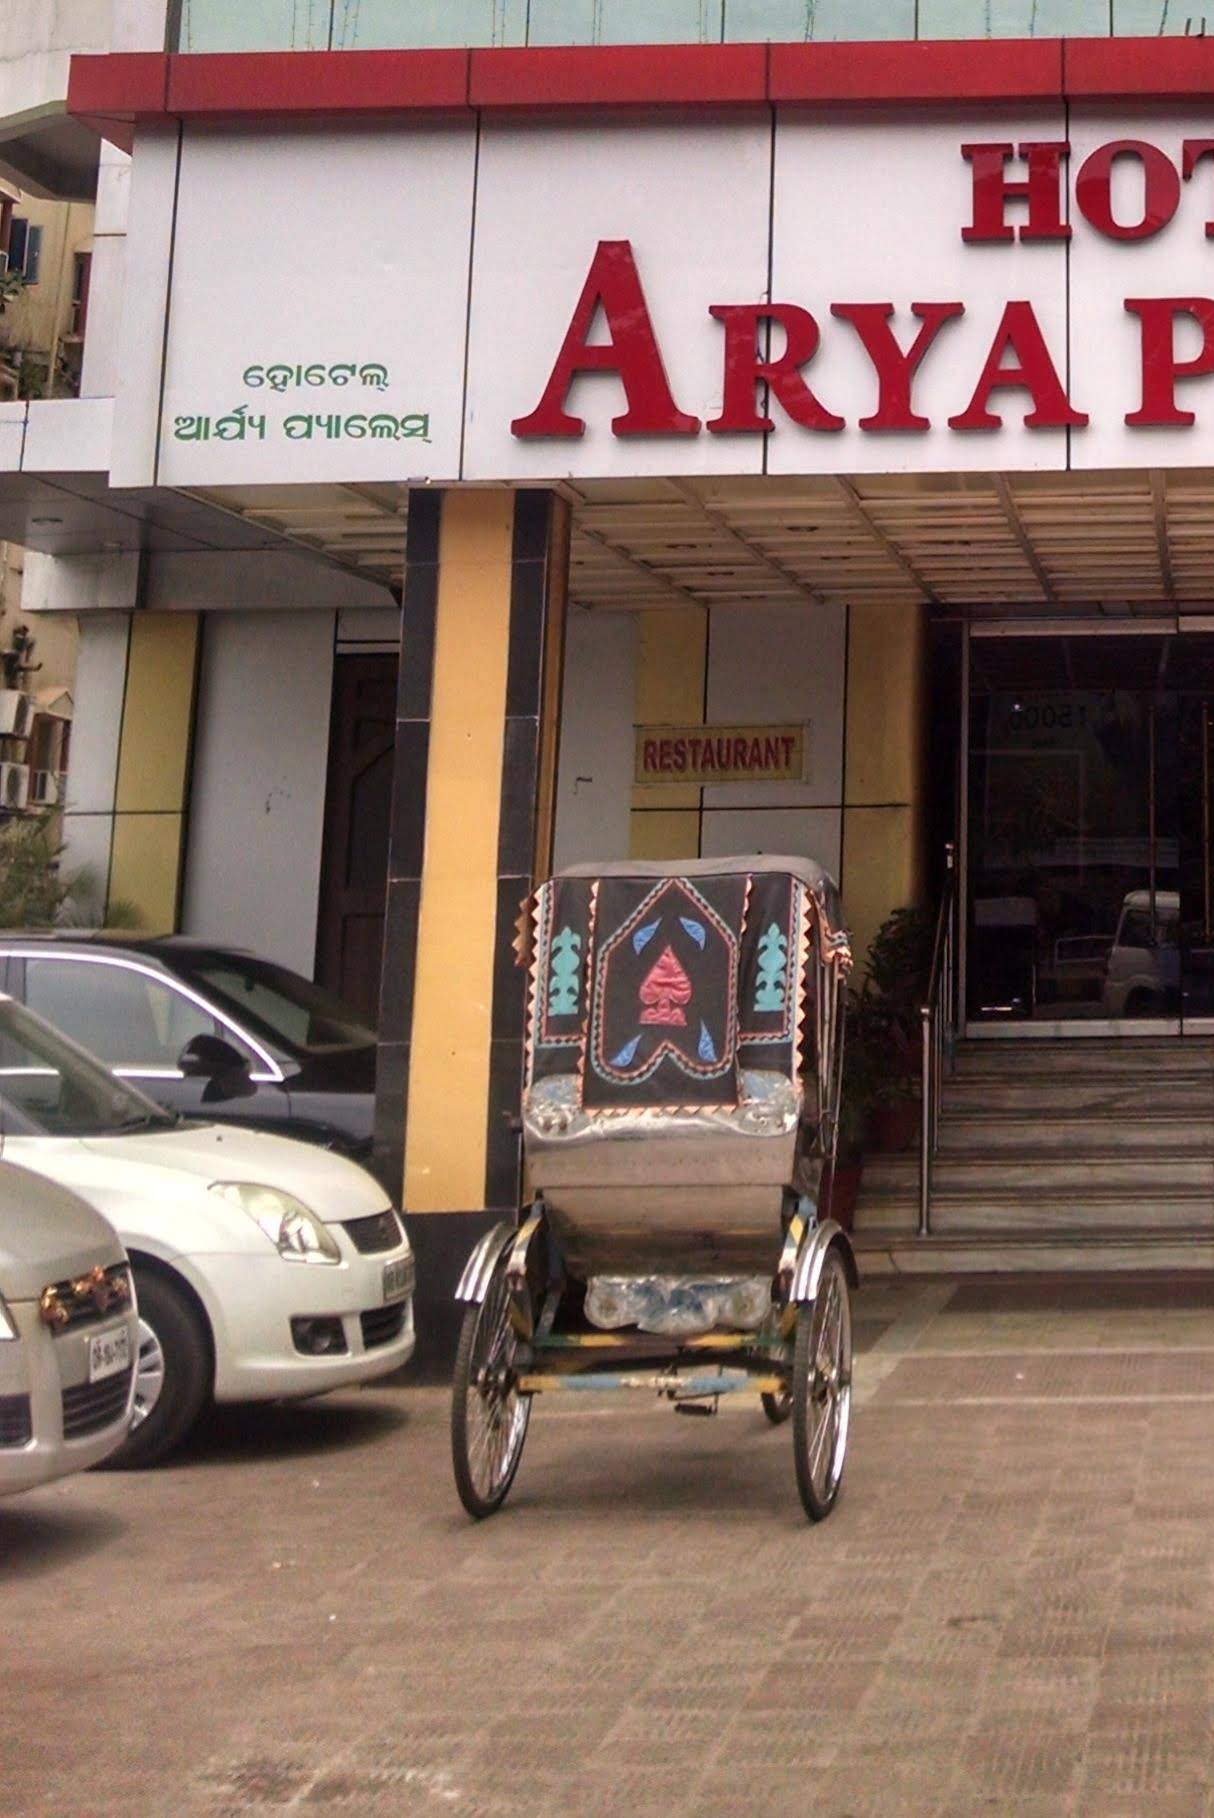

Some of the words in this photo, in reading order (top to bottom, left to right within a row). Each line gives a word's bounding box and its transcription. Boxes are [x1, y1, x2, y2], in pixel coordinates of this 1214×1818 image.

[511, 239, 1089, 438] ARYA
[243, 363, 389, 392] ହୋଟେଲ୍
[643, 736, 795, 773] RESTAURANT
